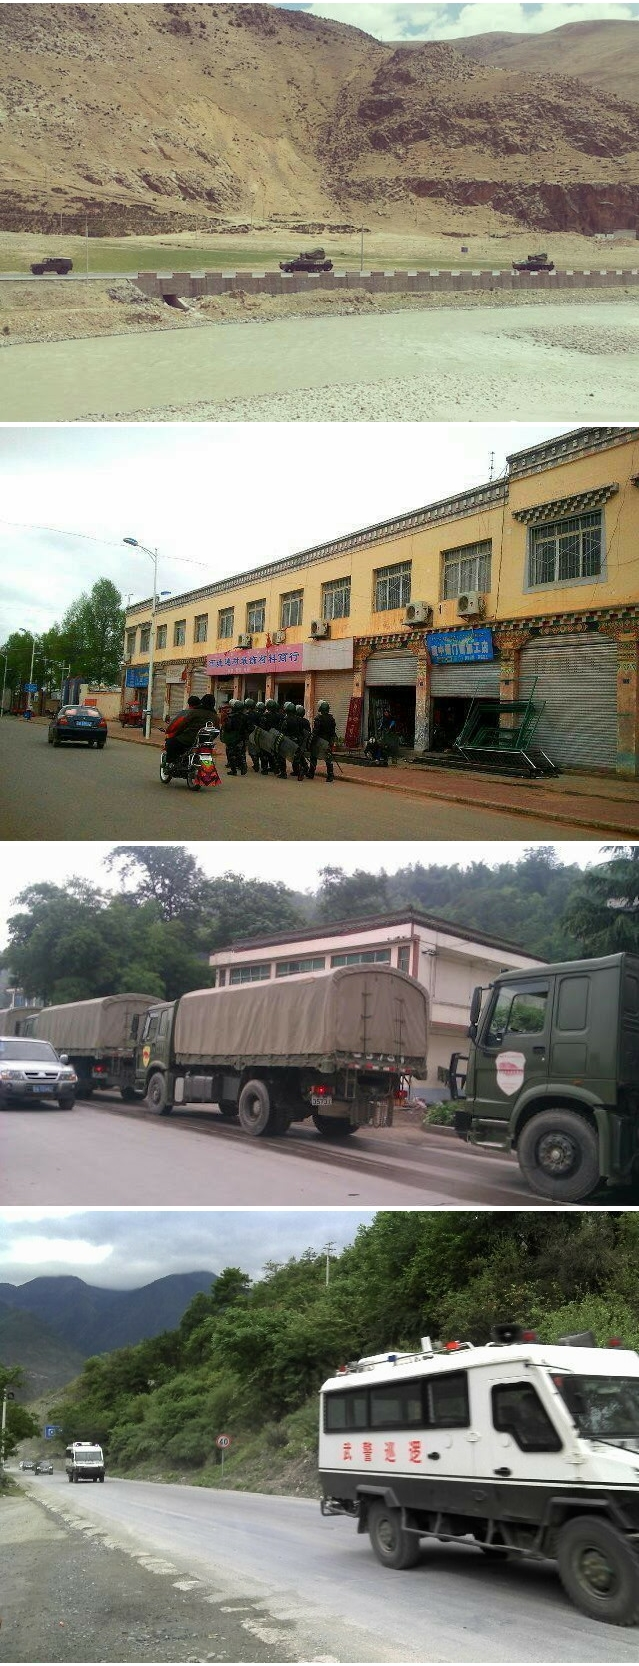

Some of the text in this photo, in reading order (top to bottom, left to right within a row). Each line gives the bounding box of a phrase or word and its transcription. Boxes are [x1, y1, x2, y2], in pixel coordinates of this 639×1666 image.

[219, 1438, 229, 1446] 40
[343, 1440, 422, 1463] 武警巡逻
